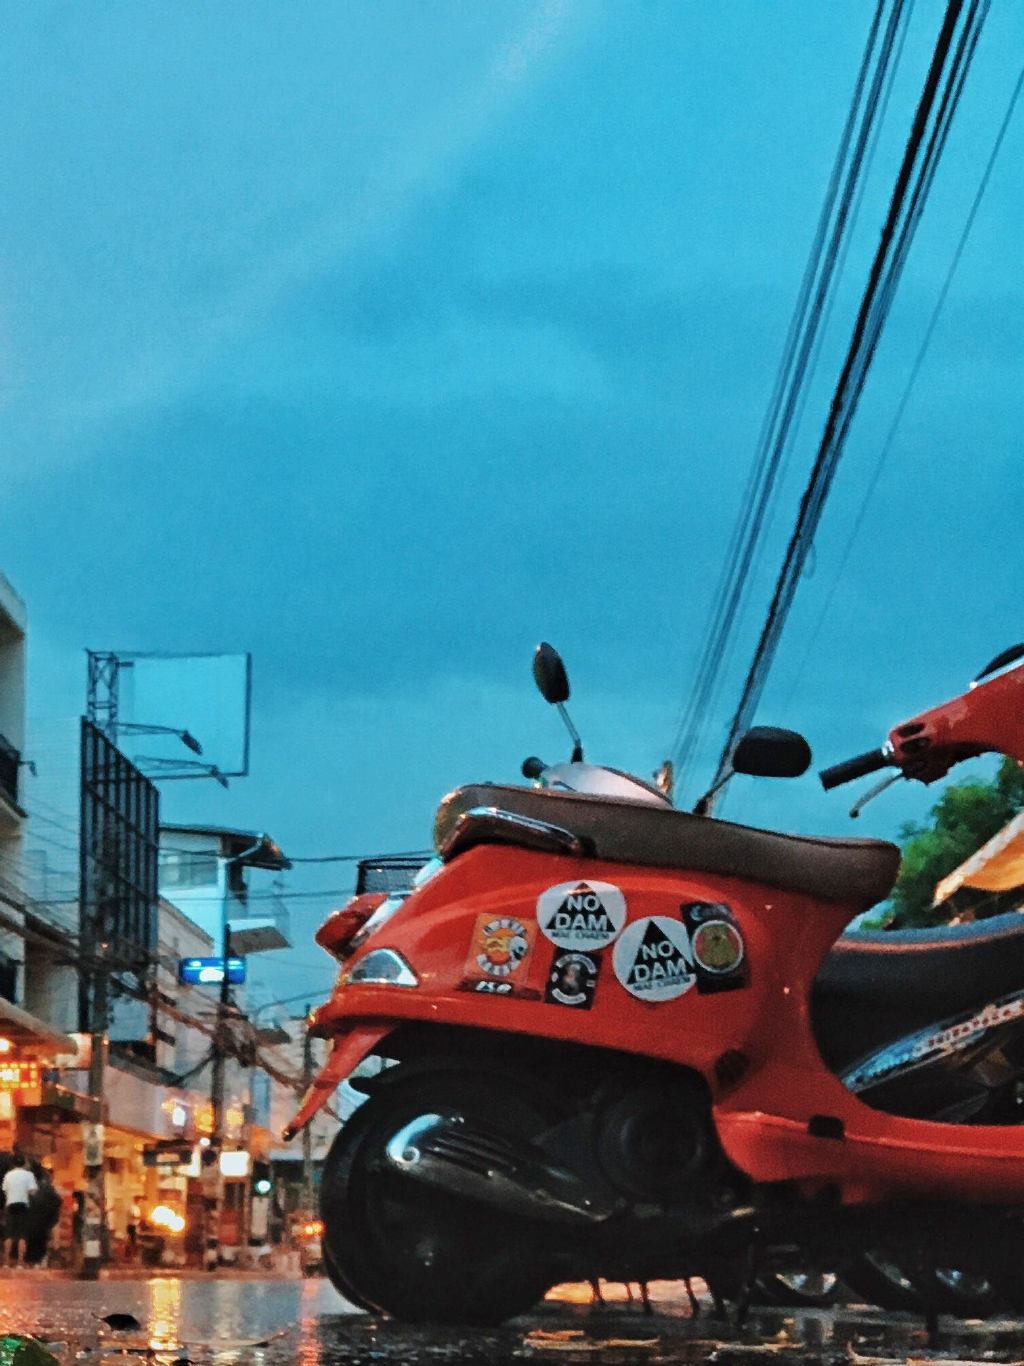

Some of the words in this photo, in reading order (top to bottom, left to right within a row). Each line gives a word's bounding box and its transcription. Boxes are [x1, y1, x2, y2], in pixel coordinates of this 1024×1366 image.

[567, 894, 600, 912] NO
[556, 913, 608, 931] DAM
[640, 940, 675, 960] NO
[634, 959, 688, 982] DAM
